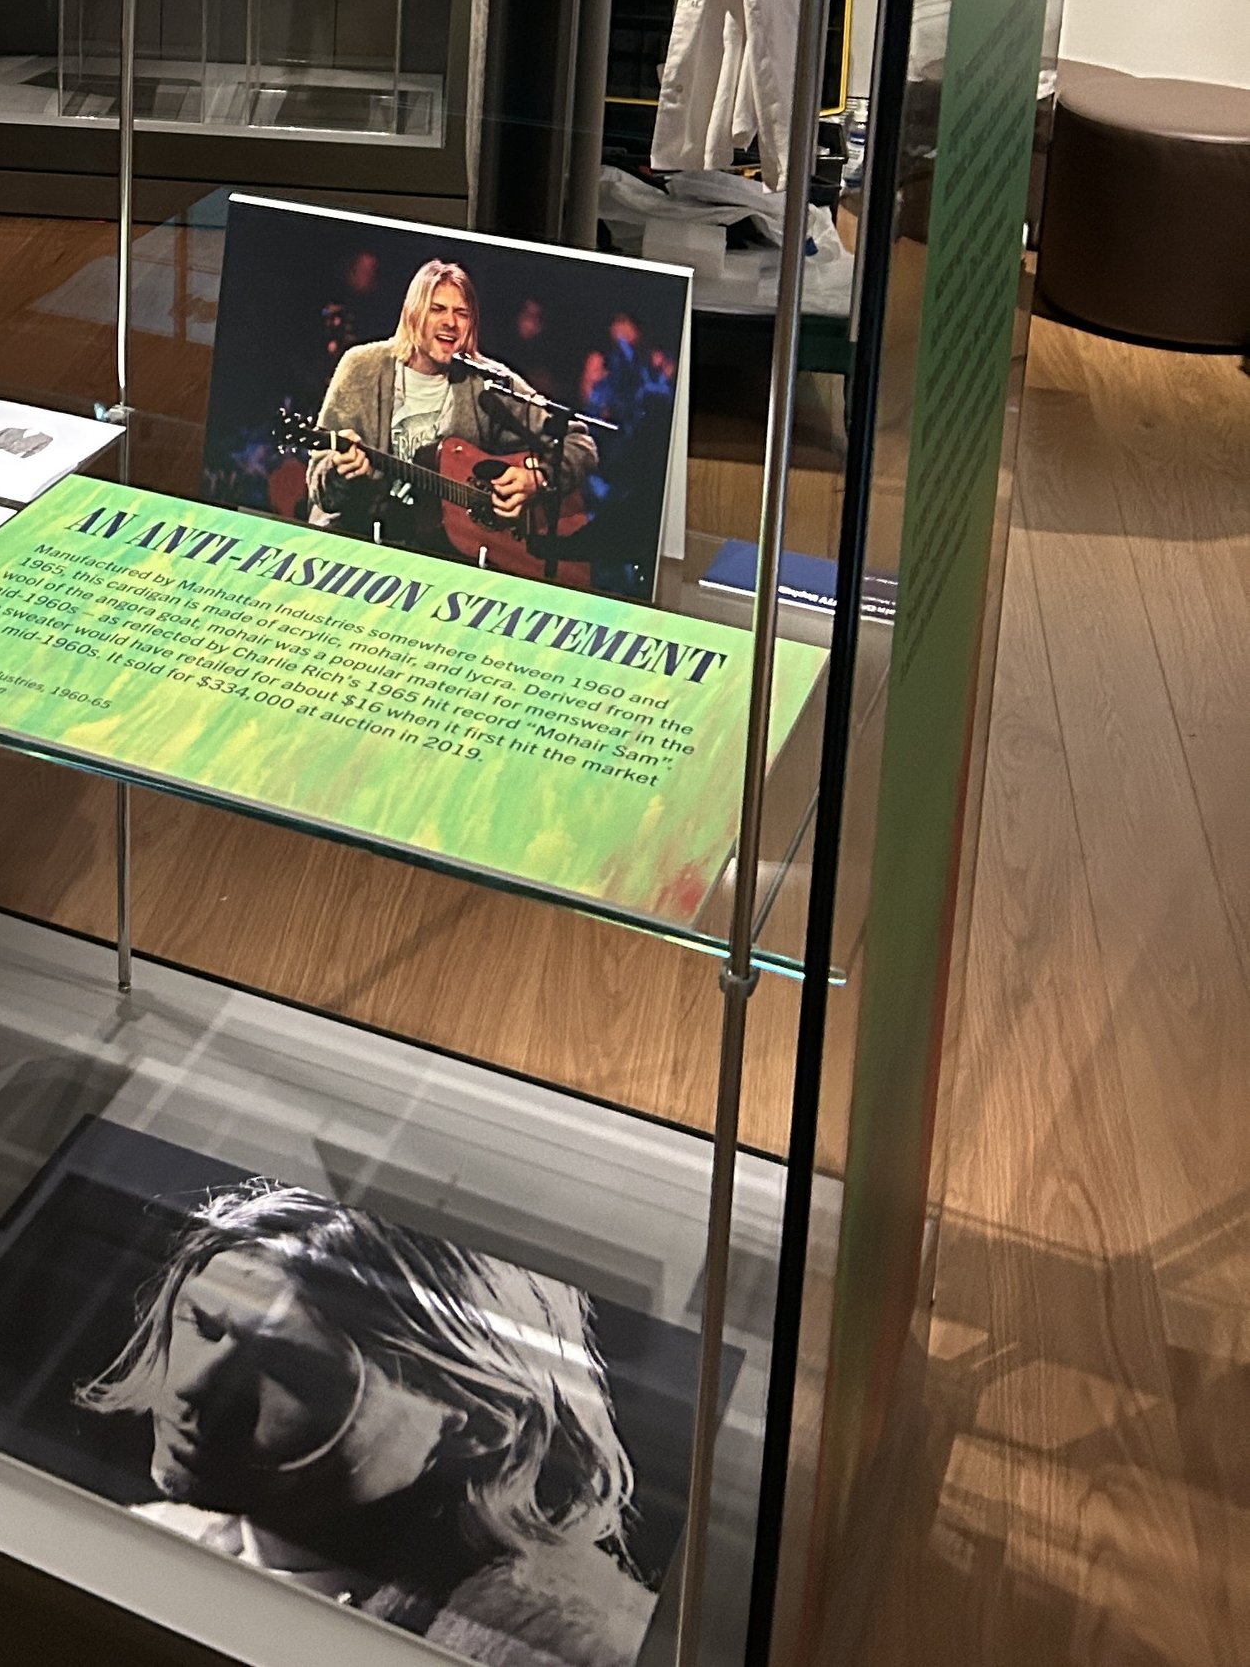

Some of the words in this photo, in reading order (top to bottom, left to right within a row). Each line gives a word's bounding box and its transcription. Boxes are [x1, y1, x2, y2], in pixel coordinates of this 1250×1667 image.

[2, 570, 44, 589] wool
[44, 580, 66, 594] of
[69, 585, 94, 601] the
[95, 594, 158, 620] angora
[156, 610, 202, 630] goat,
[206, 622, 274, 646] mohair
[275, 640, 312, 656] was
[314, 650, 328, 661] a
[327, 654, 405, 683] popular
[407, 674, 492, 704] material
[492, 696, 523, 712] for
[525, 704, 632, 740] menswear
[634, 731, 655, 746] in
[659, 738, 696, 756] the
[18, 556, 67, 578] 1965,
[72, 570, 102, 586] this
[106, 580, 182, 606] cardigan
[184, 598, 200, 610] is
[202, 604, 254, 624] made
[256, 616, 278, 630] of
[277, 622, 342, 650] acrylic,
[348, 642, 418, 666] mohair,
[424, 659, 464, 677] and
[465, 670, 517, 692] lycra.
[524, 684, 602, 712] Derived
[606, 704, 654, 726] from
[659, 718, 694, 735] the
[34, 544, 152, 580] Manufactured
[154, 574, 175, 588] by
[178, 579, 271, 608] Manhattan
[274, 604, 366, 634] Industries
[368, 629, 477, 662] somewhere
[480, 652, 566, 684] between
[571, 678, 626, 700] 1960
[629, 692, 670, 710] and
[65, 507, 139, 539] AN
[126, 521, 434, 613] ANTI-FASHION
[431, 591, 728, 685] STATEMENT
[2, 625, 101, 658] mid-1960s.
[106, 652, 126, 664] It
[124, 657, 165, 676] sold
[166, 668, 198, 684] for
[198, 676, 296, 710] $334,000
[296, 702, 318, 718] at
[319, 708, 397, 739] auction
[398, 728, 420, 742] in
[422, 735, 484, 762] 2019.
[3, 607, 74, 632] sweater
[74, 624, 128, 646] would
[128, 638, 174, 658] have
[176, 651, 250, 678] retailed
[250, 670, 282, 686] for
[280, 680, 339, 704] about
[340, 694, 386, 714] $16
[386, 707, 447, 732] when
[448, 720, 462, 734] it
[462, 726, 507, 749] first
[508, 738, 538, 756] hit
[542, 747, 578, 766] the
[581, 760, 659, 787] market
[50, 686, 113, 710] 1960-65
[98, 614, 118, 626] as
[121, 616, 206, 647] reflected
[206, 640, 232, 656] by
[232, 646, 298, 672] Charlie
[364, 681, 420, 704] 1965
[422, 696, 450, 714] hit
[453, 706, 521, 731] record
[526, 722, 609, 752] “Mohair
